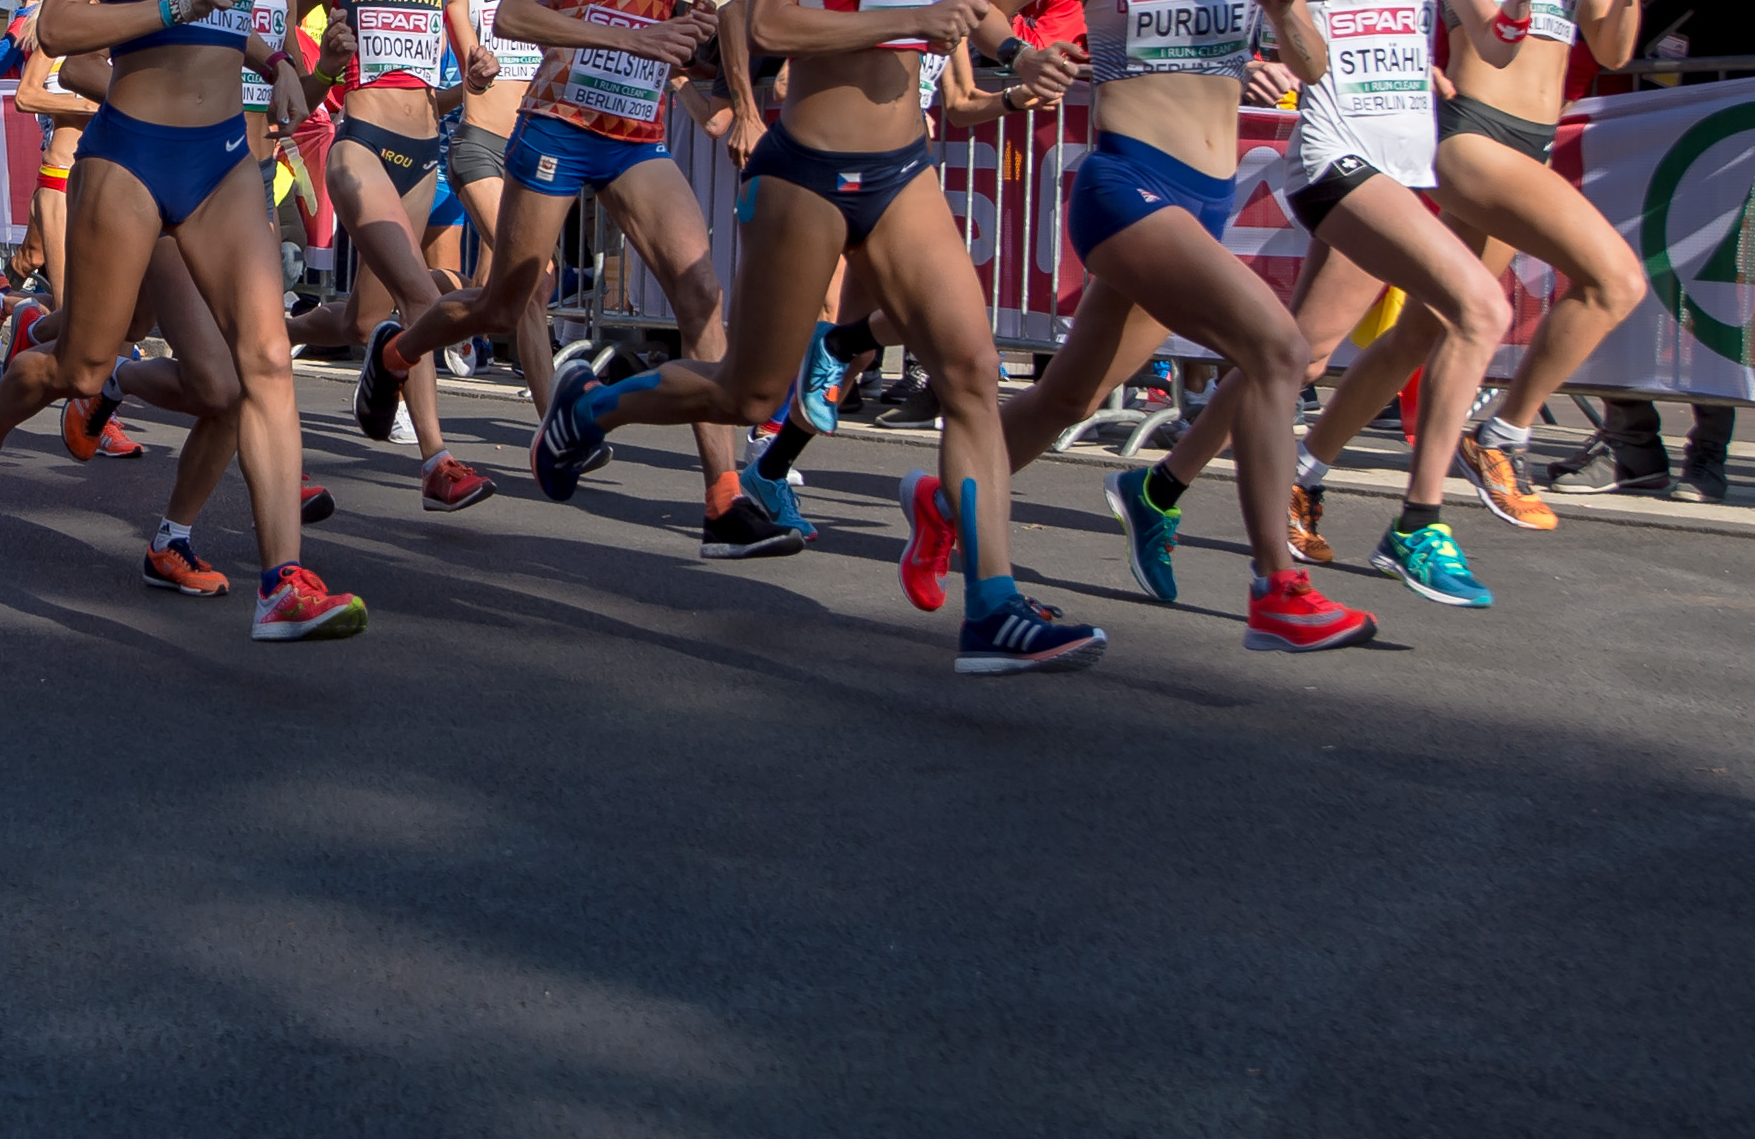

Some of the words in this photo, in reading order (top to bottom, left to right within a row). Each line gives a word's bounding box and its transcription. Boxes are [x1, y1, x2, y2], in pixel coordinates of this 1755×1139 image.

[361, 11, 427, 31] SPAR
[1136, 3, 1244, 37] PURDUE
[1331, 10, 1415, 36] SPAR
[363, 36, 432, 60] TODORAN
[1168, 47, 1195, 57] RUN
[1198, 44, 1231, 56] CLEAN
[1340, 43, 1423, 75] STRÄHL
[579, 48, 655, 83] DEELSTRA
[599, 80, 620, 93] RUN
[621, 85, 646, 98] CLEAN
[1371, 81, 1393, 92] RUN
[1395, 80, 1420, 91] CLEAN
[575, 87, 626, 112] BERLIN
[628, 101, 653, 119] 2018
[1352, 95, 1405, 111] BERLIN
[1408, 95, 1427, 110] 2018
